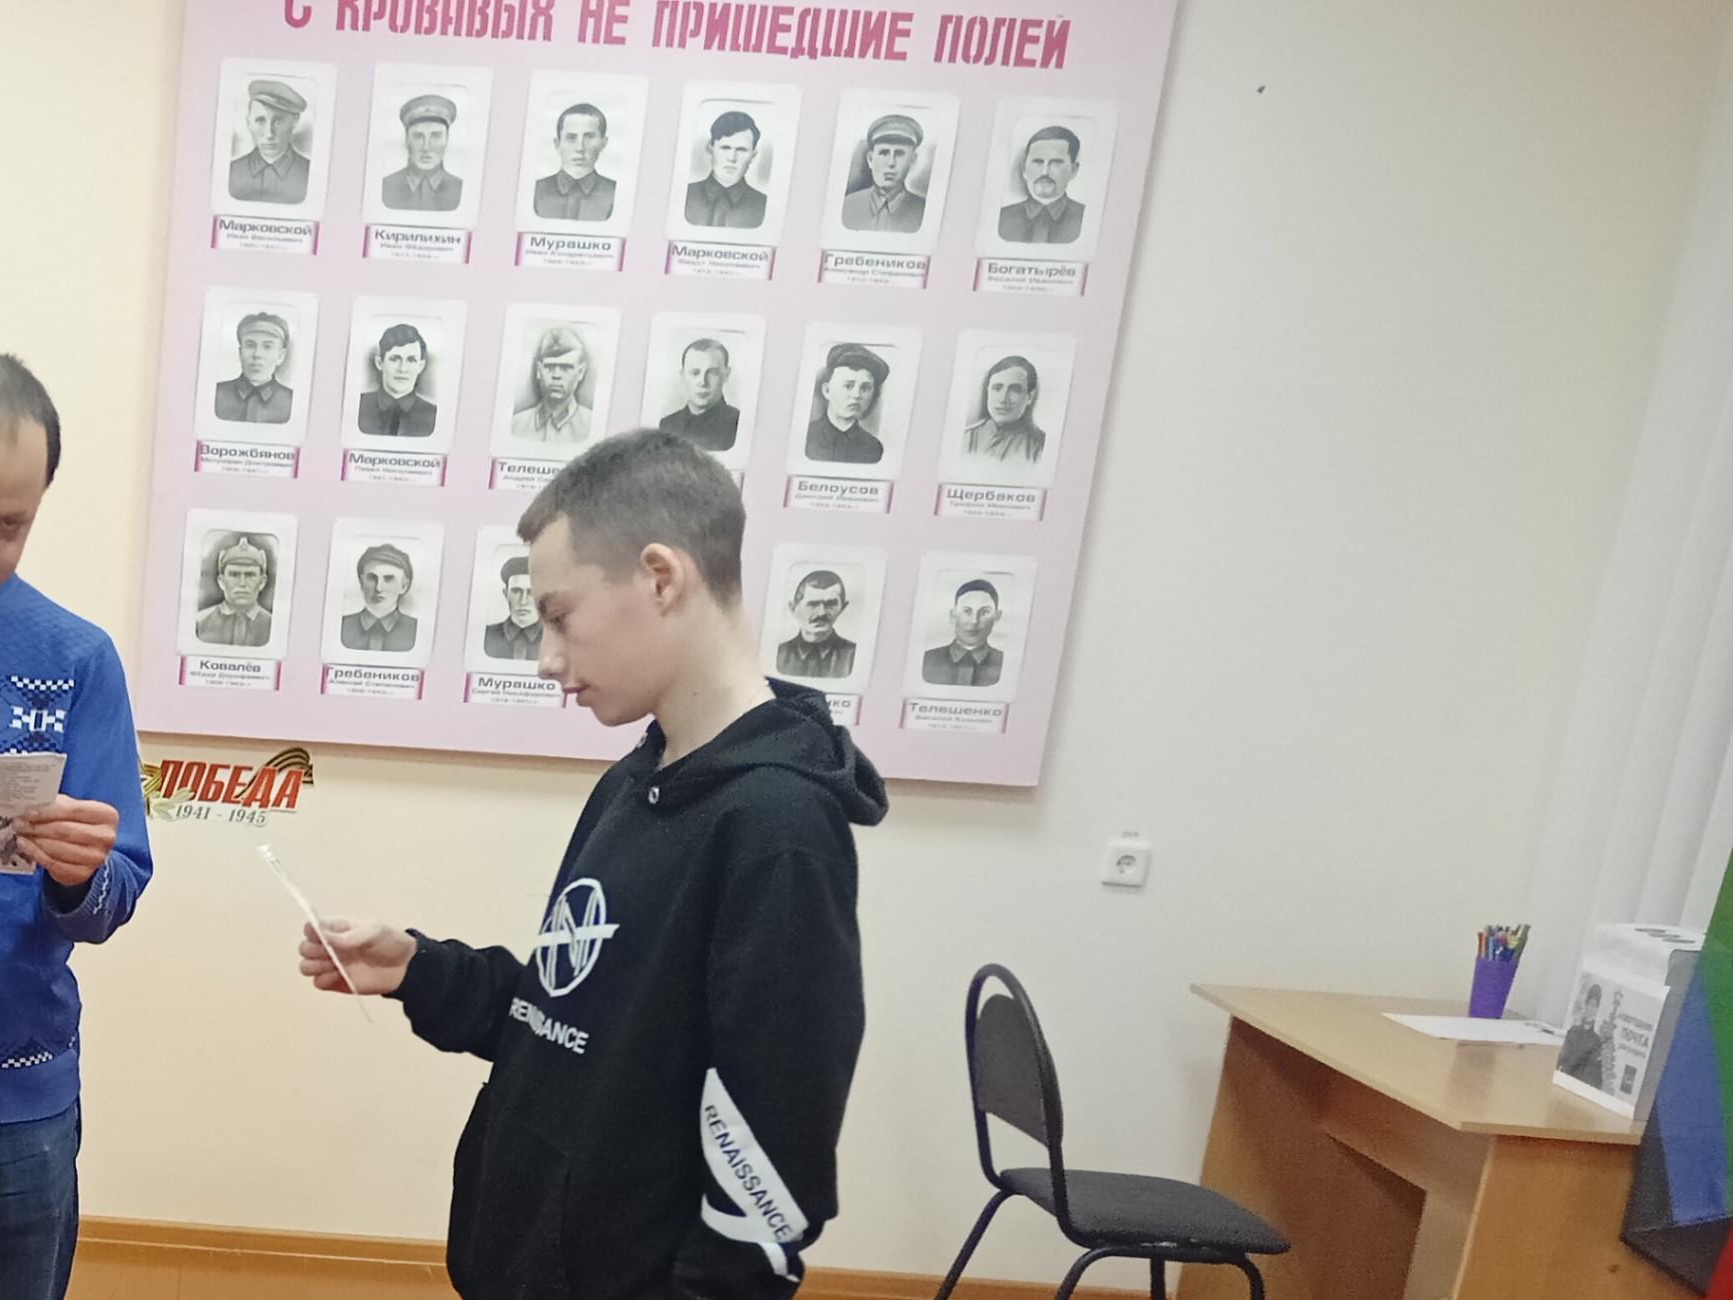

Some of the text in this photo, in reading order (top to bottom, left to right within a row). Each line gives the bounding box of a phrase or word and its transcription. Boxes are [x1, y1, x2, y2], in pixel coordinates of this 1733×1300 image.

[335, 0, 556, 41] КРОВАВЫХ
[578, 0, 631, 45] НЕ
[652, 0, 915, 60] ПРИШЕДШИЕ
[933, 14, 1072, 69] ПОЛЕЙ
[218, 219, 312, 235] Марковской
[530, 236, 612, 250] Мурашко
[672, 245, 769, 261] Марковской
[987, 262, 1077, 278] Богатырёв
[349, 452, 441, 468] Марковской
[498, 461, 562, 475] Телеше
[798, 480, 879, 496] Белоусов
[946, 488, 1036, 503] Щербаков
[199, 660, 262, 673] Ковалёв
[478, 677, 556, 691] Мурашко
[160, 759, 305, 810] ПОБЕДА
[175, 804, 211, 821] 1941
[228, 808, 266, 825] 1945
[704, 1104, 792, 1244] RENAISSANCE
